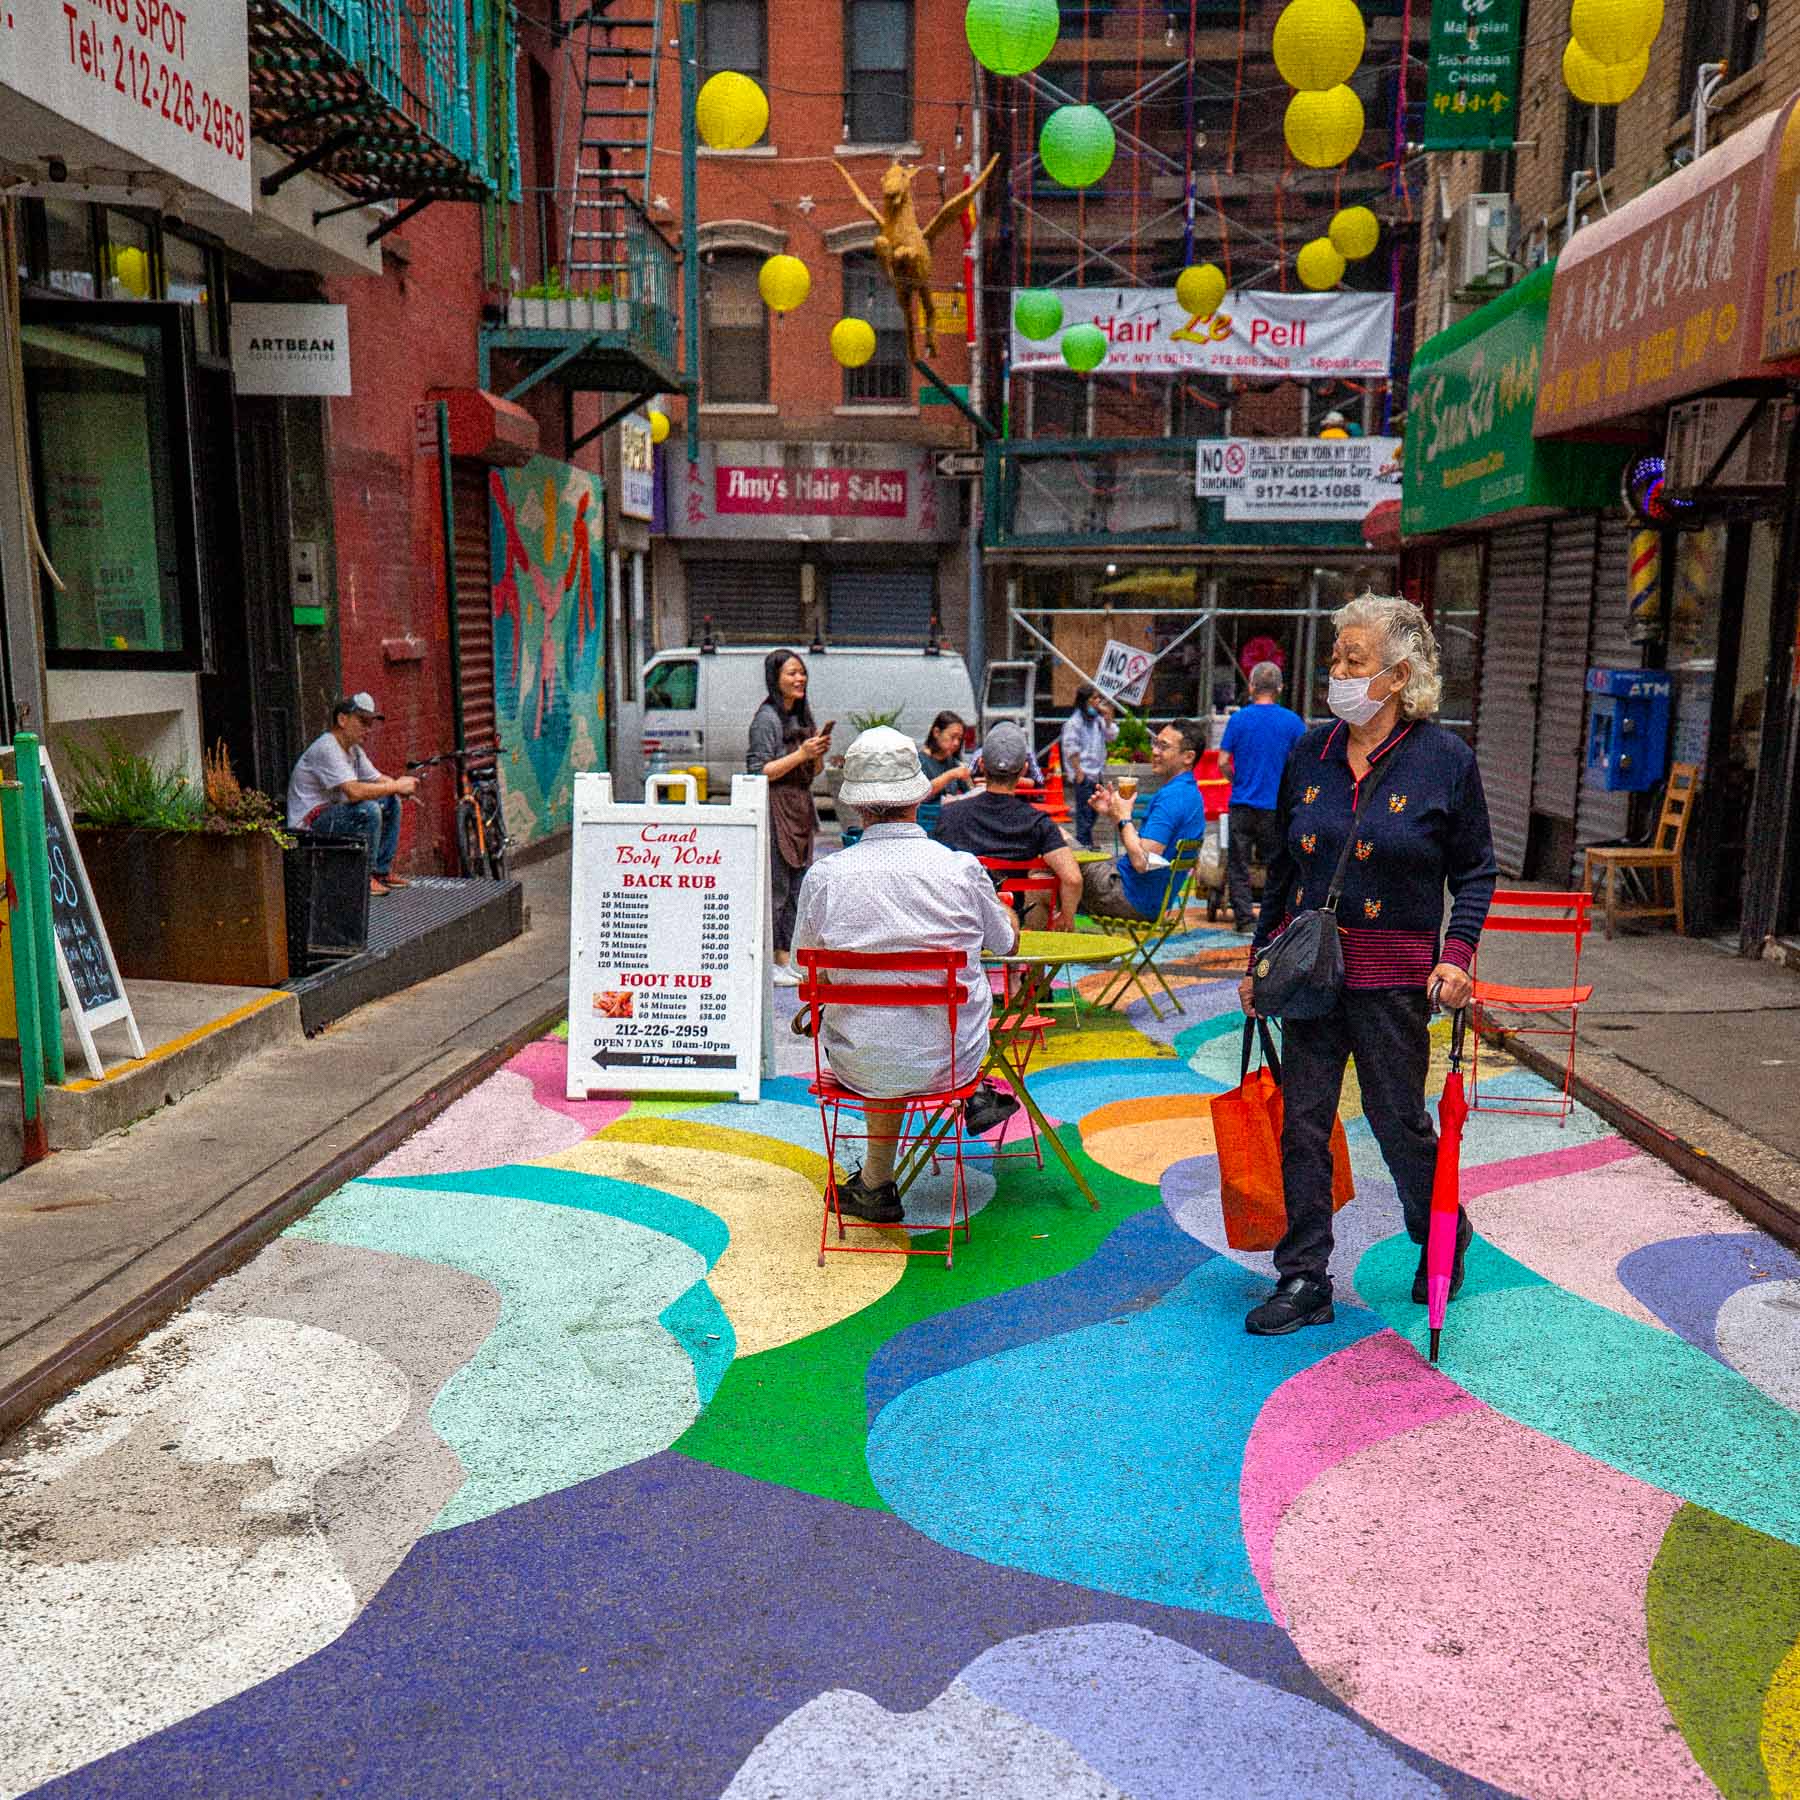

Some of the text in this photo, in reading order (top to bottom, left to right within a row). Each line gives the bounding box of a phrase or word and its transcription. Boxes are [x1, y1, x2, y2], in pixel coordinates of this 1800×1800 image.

[135, 0, 187, 61] SPOT
[63, 2, 245, 161] Tel: 212-226-2959
[1092, 314, 1157, 343] Hair
[1249, 318, 1307, 347] Pell
[249, 338, 336, 352] ARTBEAN
[1202, 448, 1223, 473] NO
[727, 469, 788, 503] Amy's
[796, 472, 840, 501] Hair
[848, 475, 904, 504] Salon
[1201, 476, 1246, 490] SMOKING
[1104, 649, 1128, 675] NO
[1629, 682, 1670, 697] ATM
[640, 823, 697, 842] Canal
[615, 845, 722, 868] Body Work
[623, 874, 716, 889] BACK RUB
[612, 892, 648, 900] Minutes
[613, 902, 649, 910] Minutes
[613, 912, 649, 920] Minutes
[612, 922, 648, 930] Minutes
[612, 931, 648, 939] Minutes
[612, 941, 647, 949] Minutes
[612, 951, 648, 959] Minutes
[613, 961, 649, 969] Minutes
[620, 973, 713, 988] FOOT RUB
[639, 992, 650, 1000] 30
[651, 992, 688, 1000] Minutes
[639, 1002, 649, 1010] 45
[651, 1002, 687, 1010] Minutes
[638, 1012, 649, 1020] 60
[651, 1012, 688, 1020] Minutes
[615, 1023, 708, 1037] 212-226-2959
[593, 1038, 731, 1051] OPEN 7 DAYS 10am-10pm
[642, 1055, 697, 1066] 17 Doyers St.
